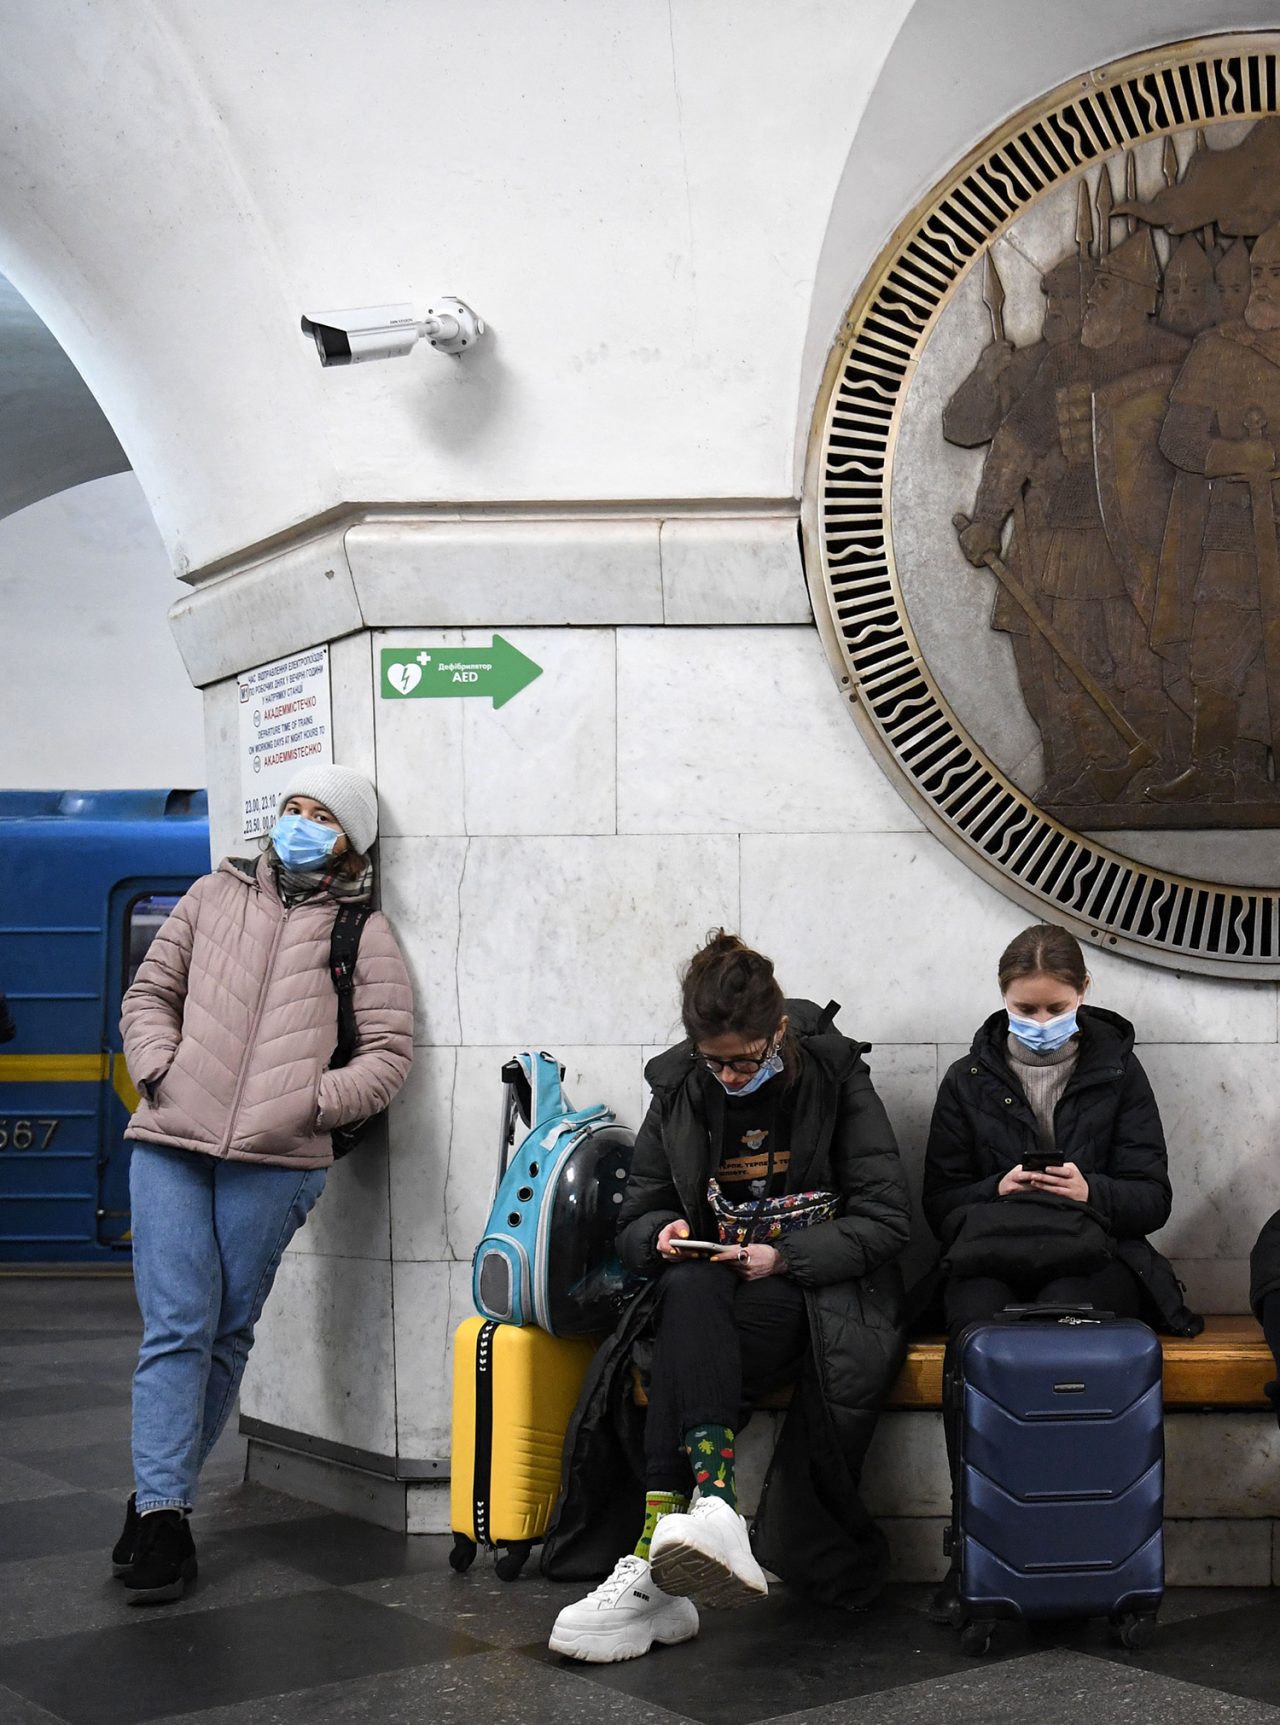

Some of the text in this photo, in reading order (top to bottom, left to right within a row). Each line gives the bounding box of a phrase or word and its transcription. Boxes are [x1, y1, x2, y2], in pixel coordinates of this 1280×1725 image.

[438, 663, 492, 671] Дефібрилятор
[452, 672, 479, 682] AED
[264, 695, 317, 720] АКАДЕММІСТЕЧКО
[255, 740, 273, 753] WORKING
[273, 737, 285, 748] DAYS
[290, 731, 303, 743] NIGHT
[303, 727, 319, 739] HOURS
[319, 725, 326, 735] TO
[257, 715, 313, 739] DEPARTURE TIME OF TRAINS
[263, 741, 322, 767] AKADEMMISTECHKO
